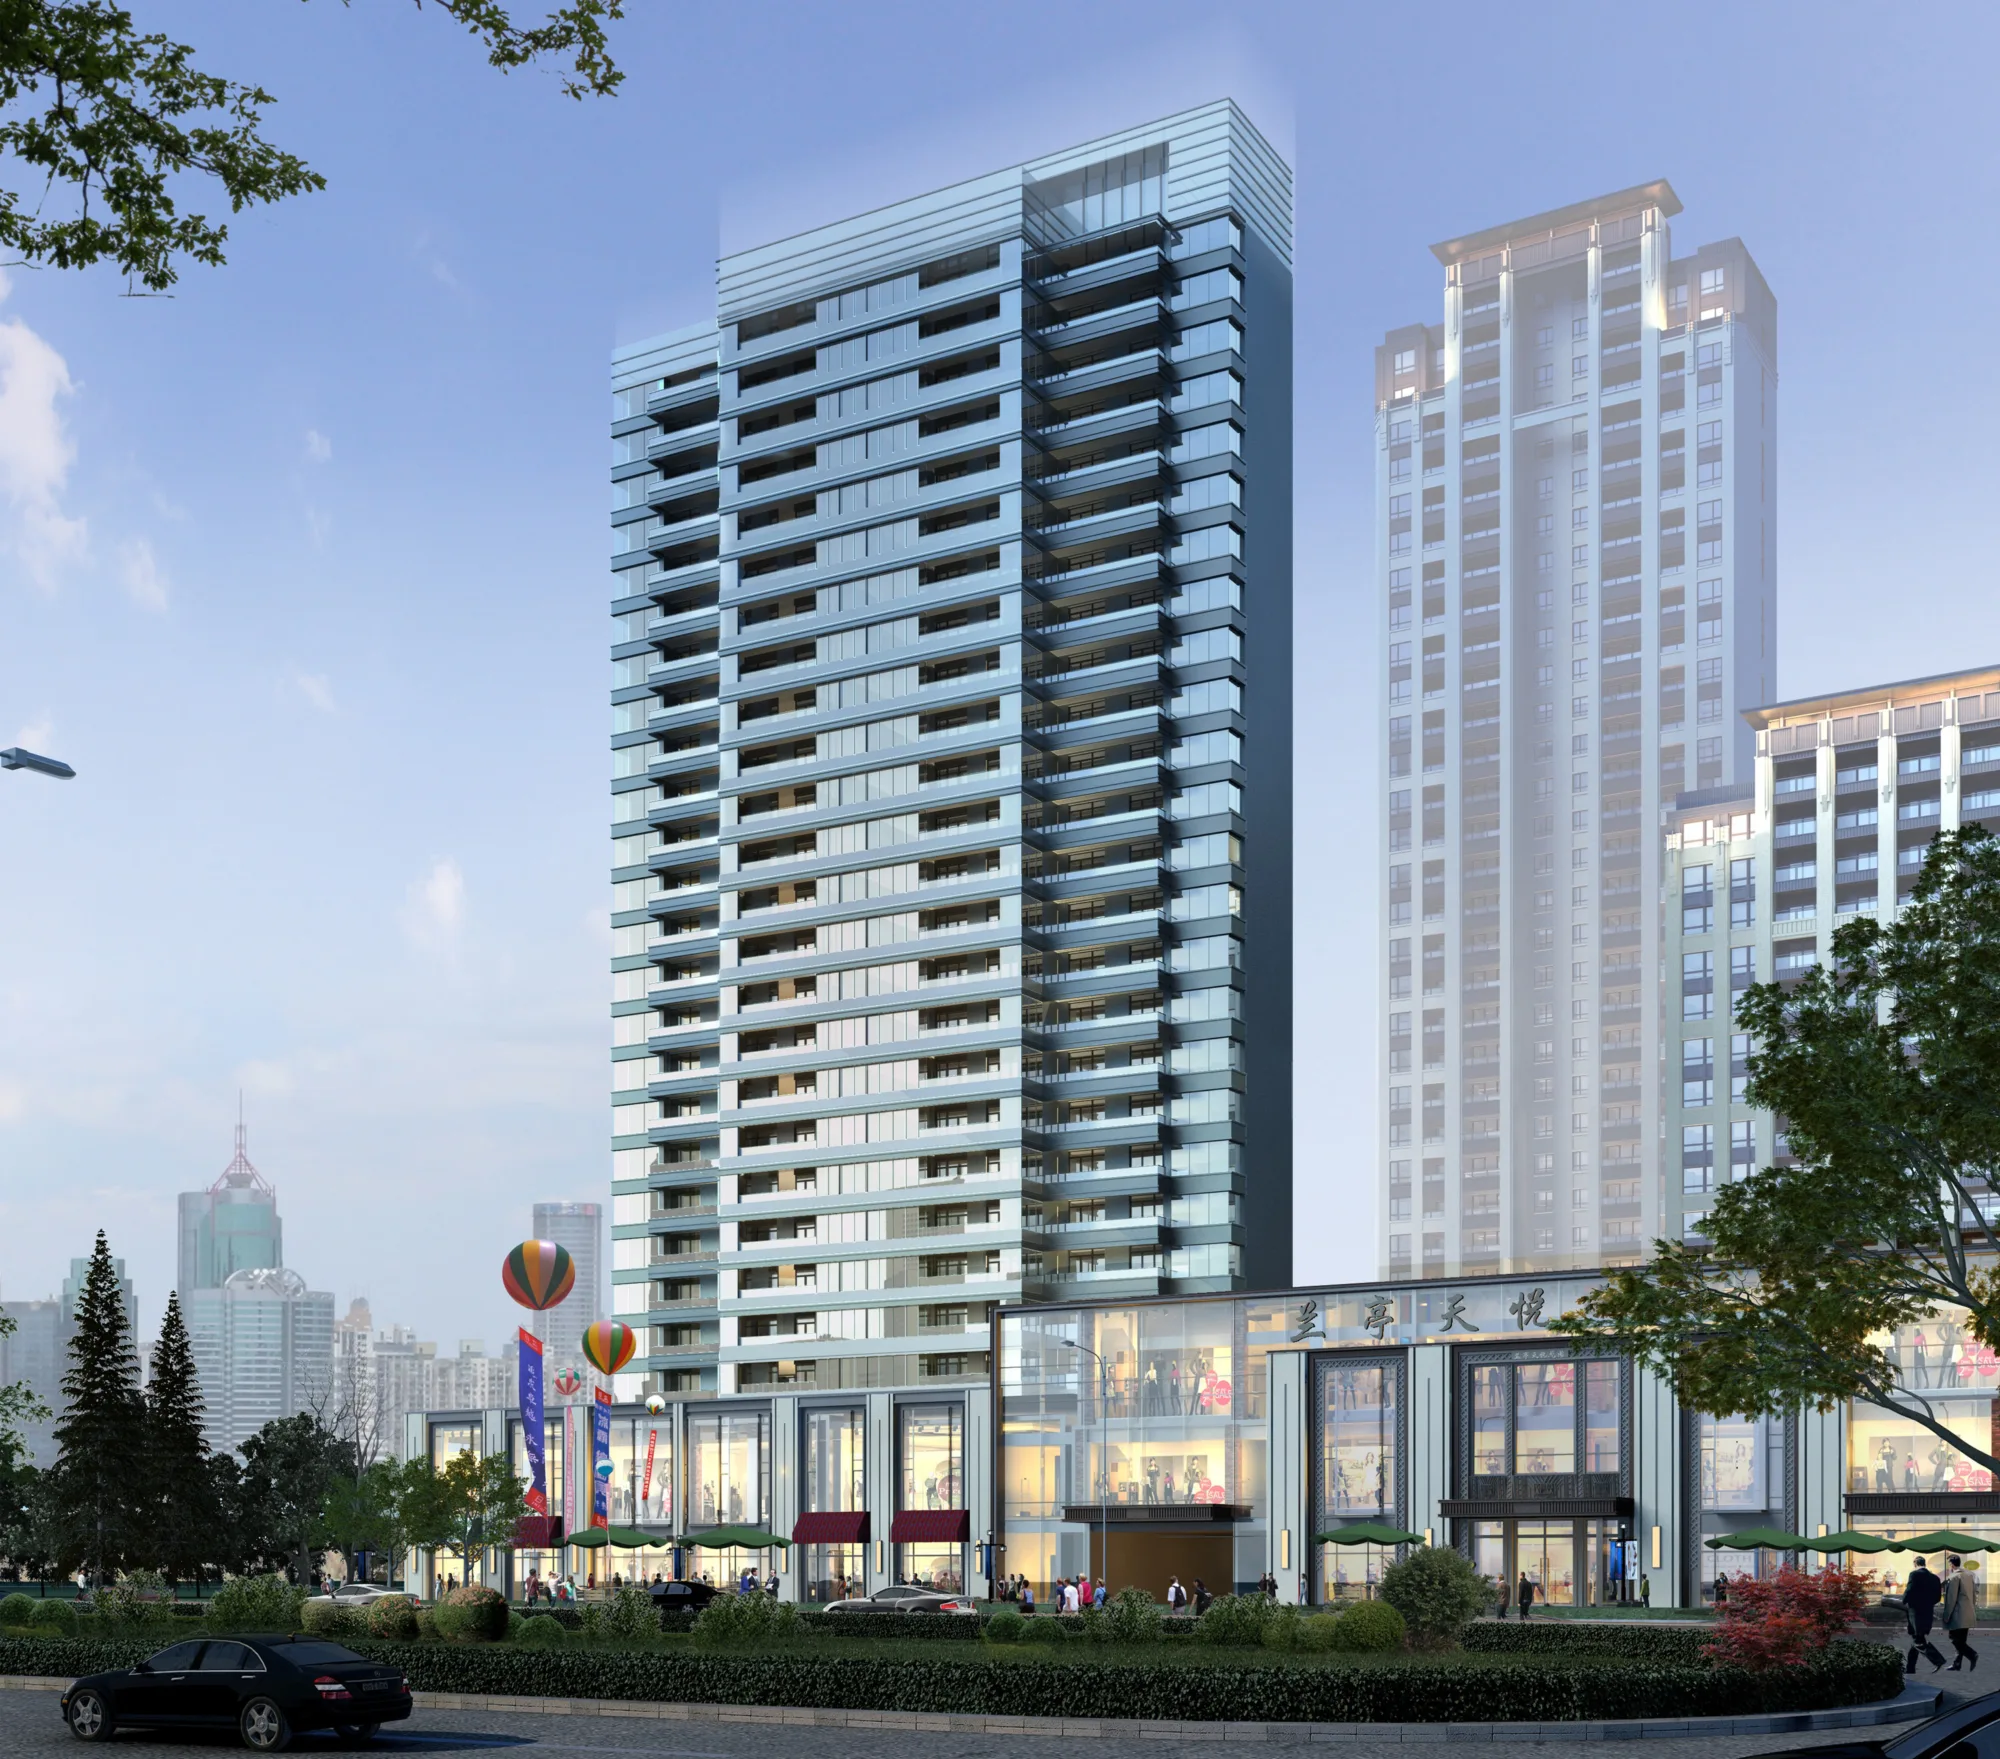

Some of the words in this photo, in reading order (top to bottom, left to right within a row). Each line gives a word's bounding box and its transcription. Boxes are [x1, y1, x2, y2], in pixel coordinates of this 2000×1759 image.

[1290, 1287, 1550, 1343] 兰亭天悦
[1968, 1476, 1992, 1487] SALE
